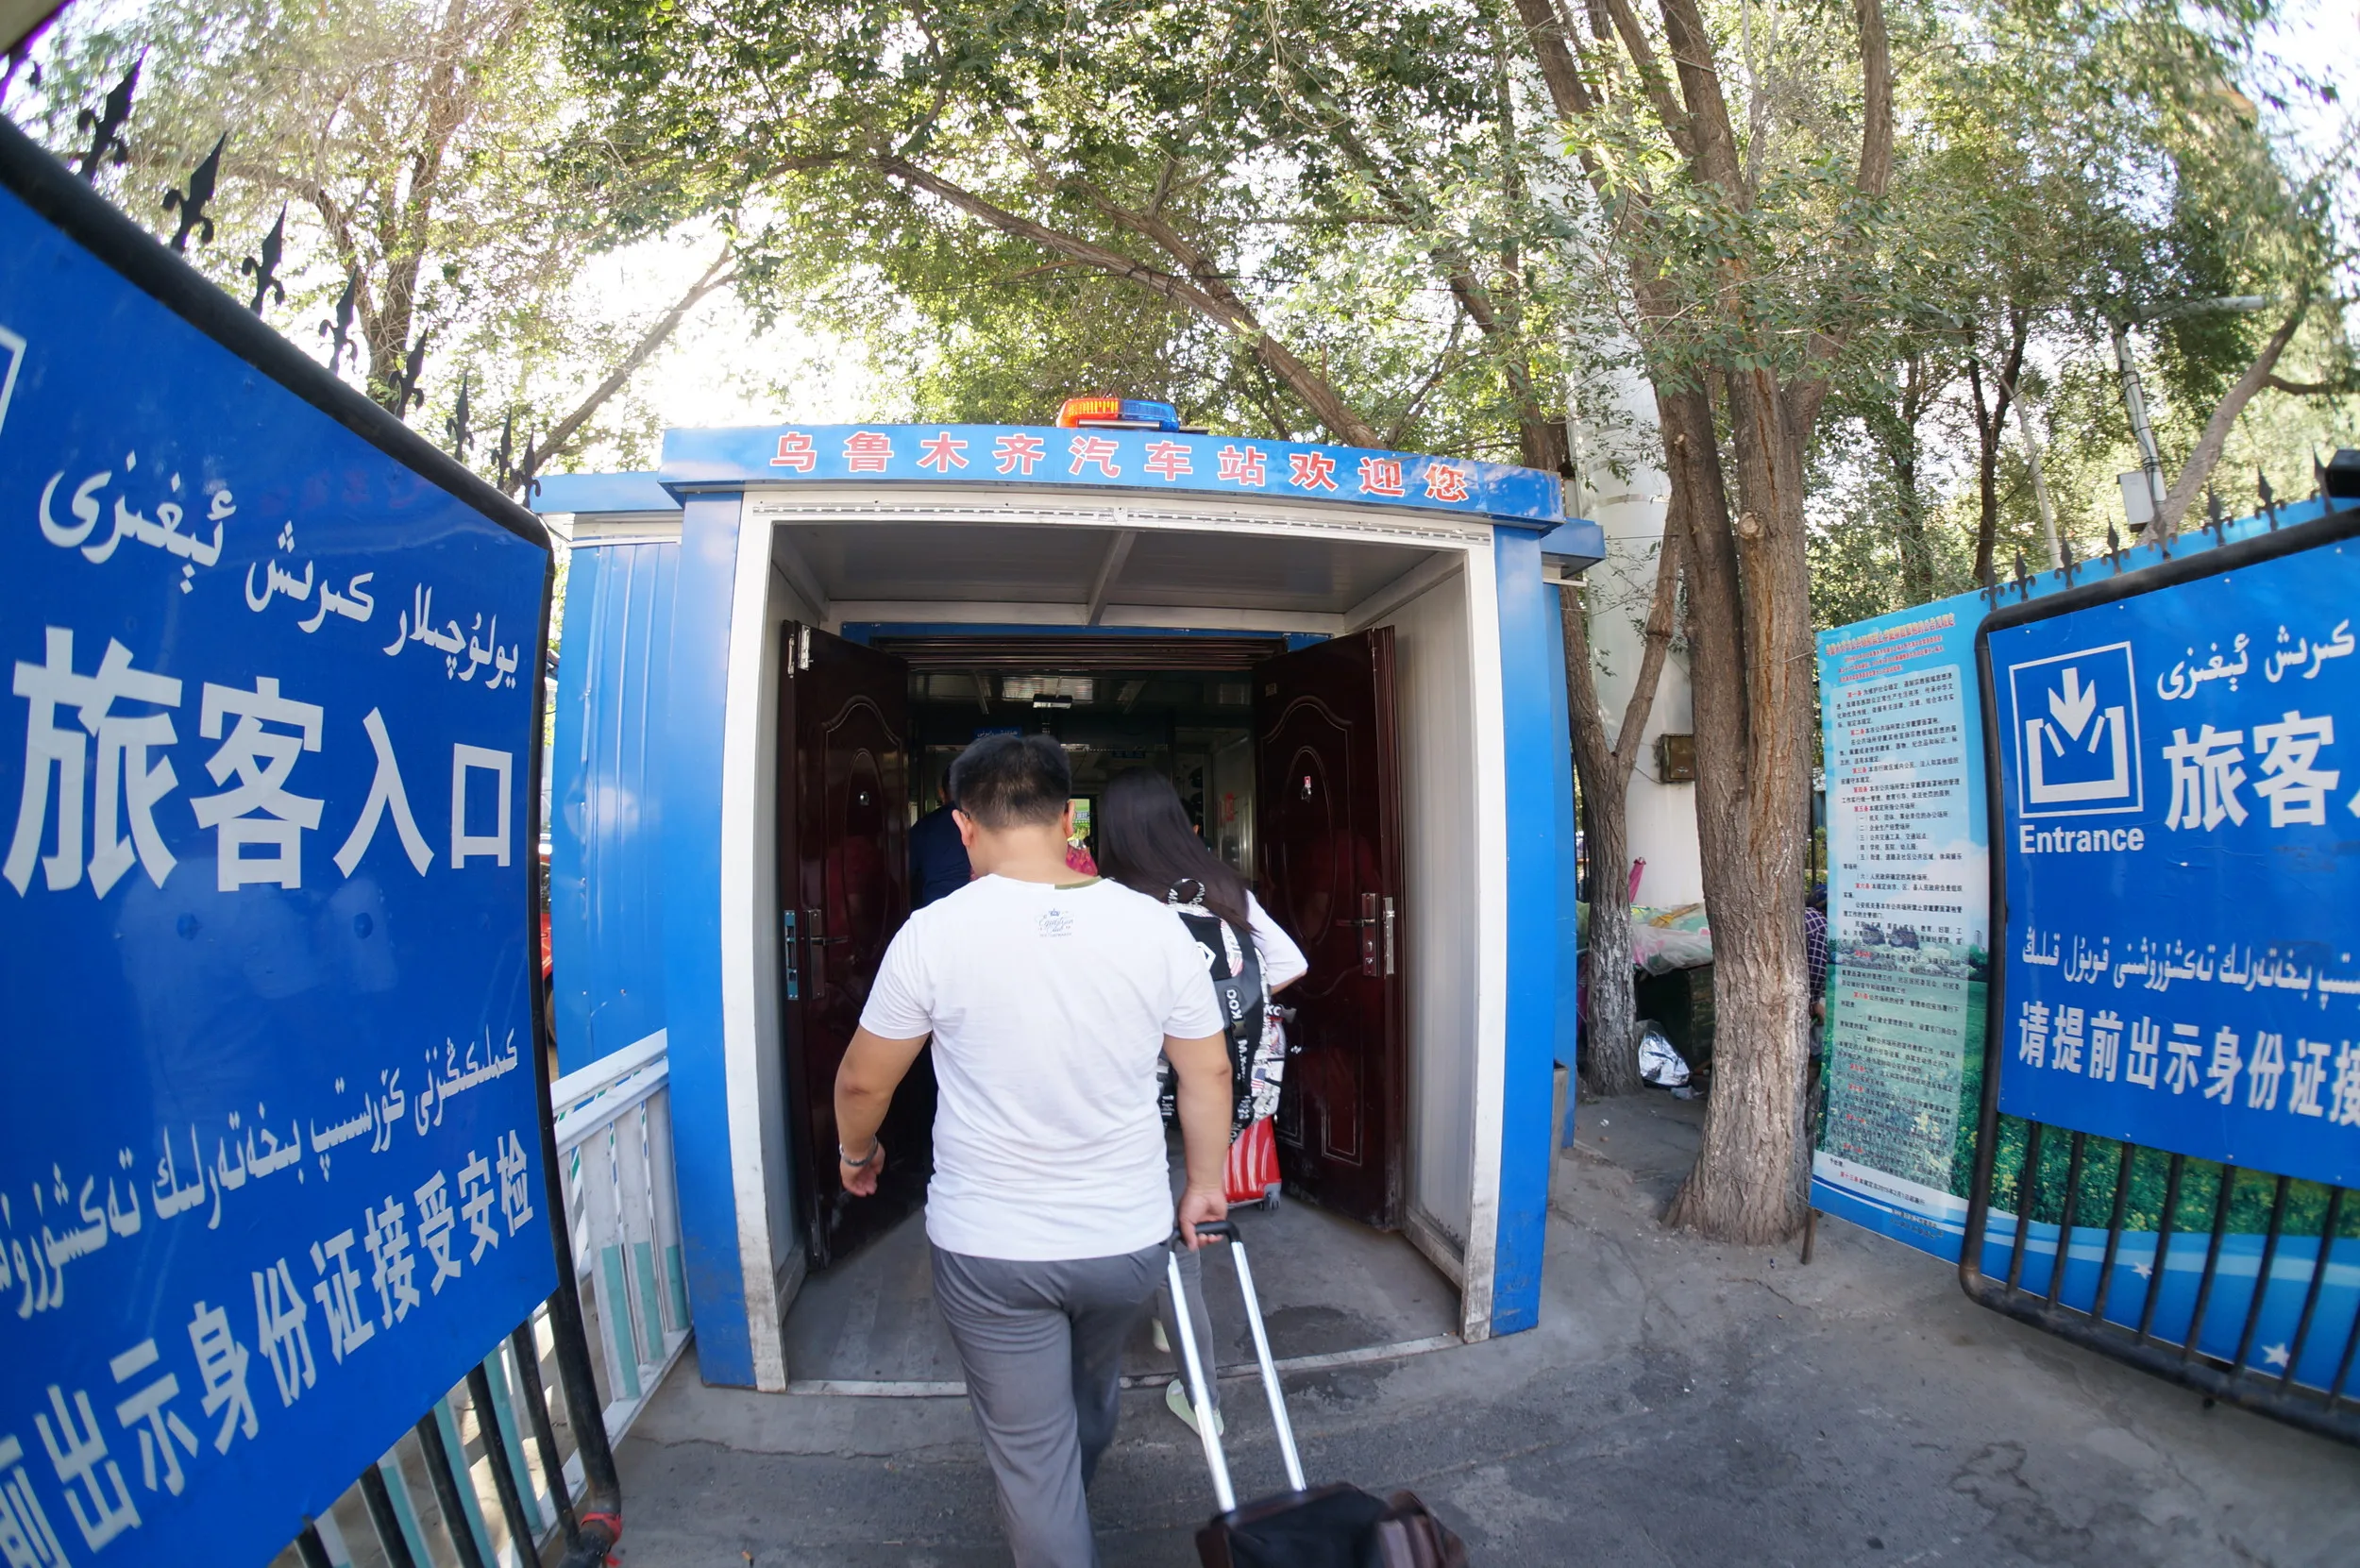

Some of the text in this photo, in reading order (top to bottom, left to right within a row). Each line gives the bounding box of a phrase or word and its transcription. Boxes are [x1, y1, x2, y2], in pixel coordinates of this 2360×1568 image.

[769, 430, 1470, 503] 乌鲁木齐汽车站欢迎您
[245, 520, 374, 633] كىرىش
[2265, 618, 2355, 683] كىرىش
[3, 624, 513, 899] 旅客入口
[2162, 710, 2360, 833] 旅客
[2019, 824, 2145, 853] Entrance
[2018, 1001, 2360, 1127] 请提前出示身份证接
